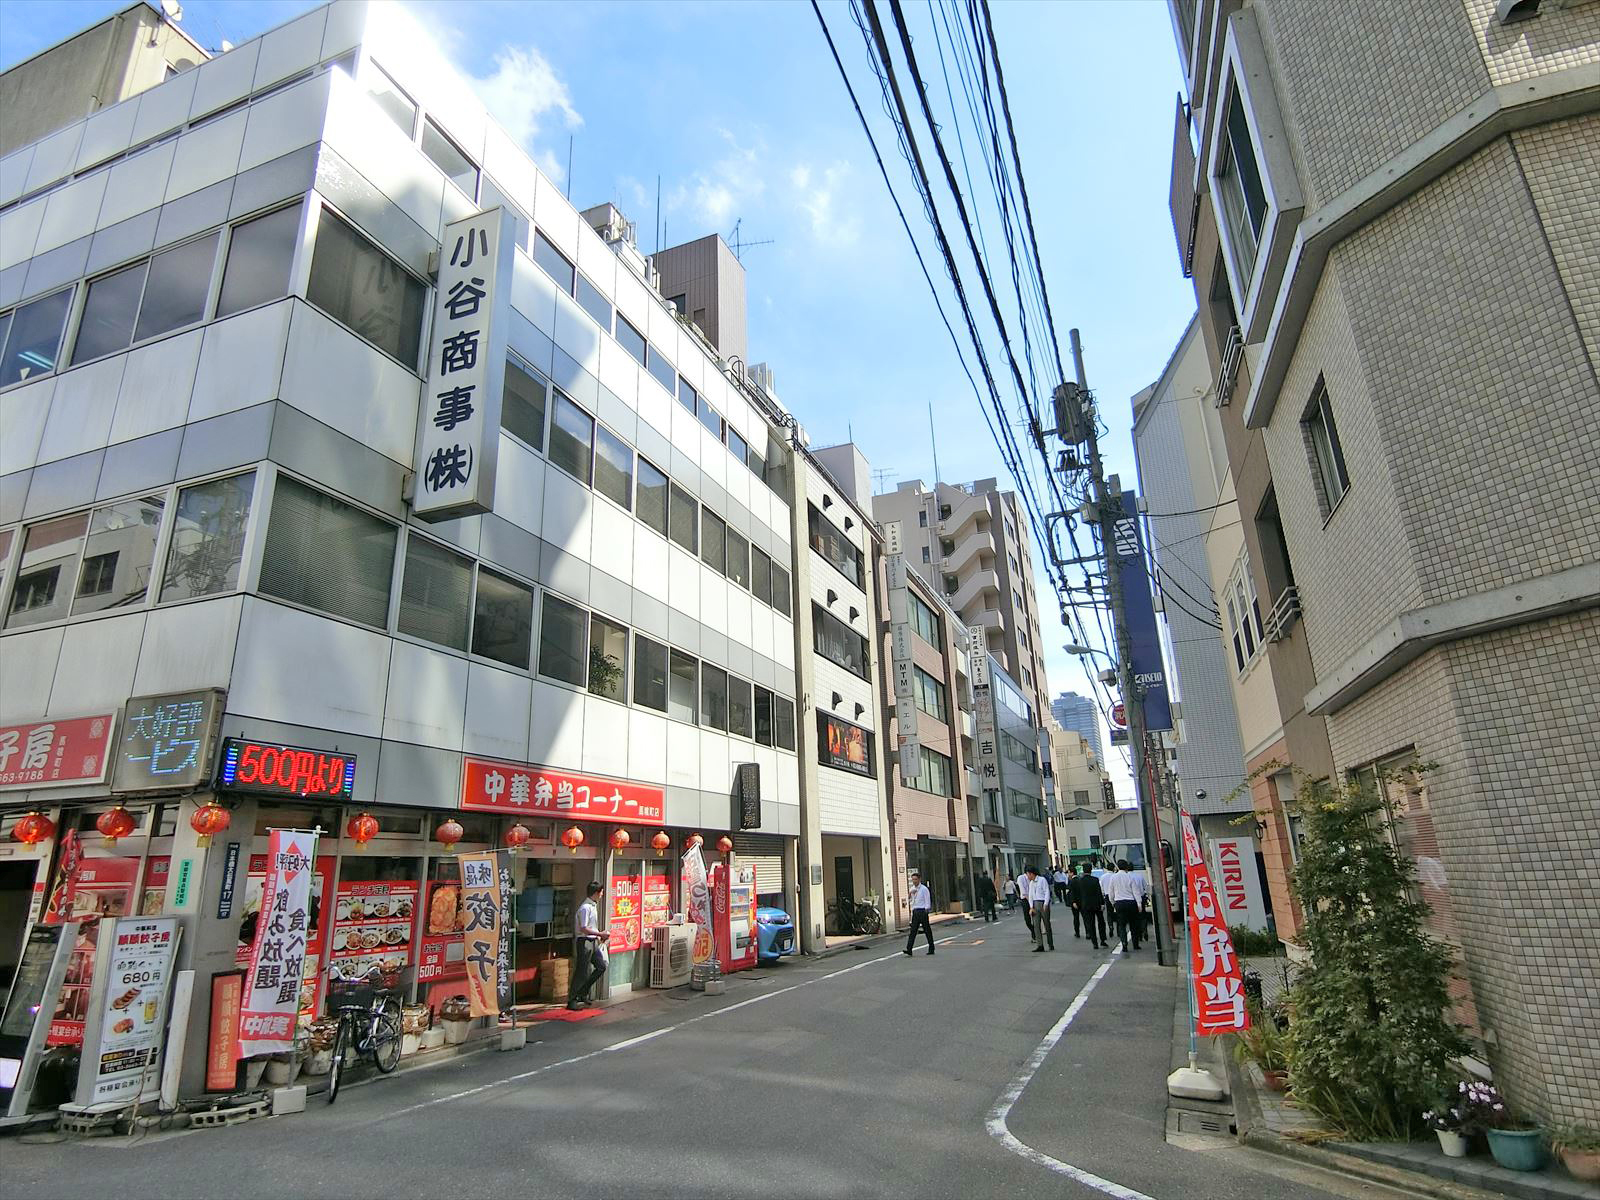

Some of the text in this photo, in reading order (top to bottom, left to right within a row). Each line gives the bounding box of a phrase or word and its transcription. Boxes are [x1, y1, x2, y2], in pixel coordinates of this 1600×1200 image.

[239, 744, 344, 795] 500円より
[484, 769, 638, 814] 中華弁当コーナー
[223, 891, 232, 900] 17
[1218, 842, 1247, 910] KIRIN
[122, 971, 161, 984] 680円
